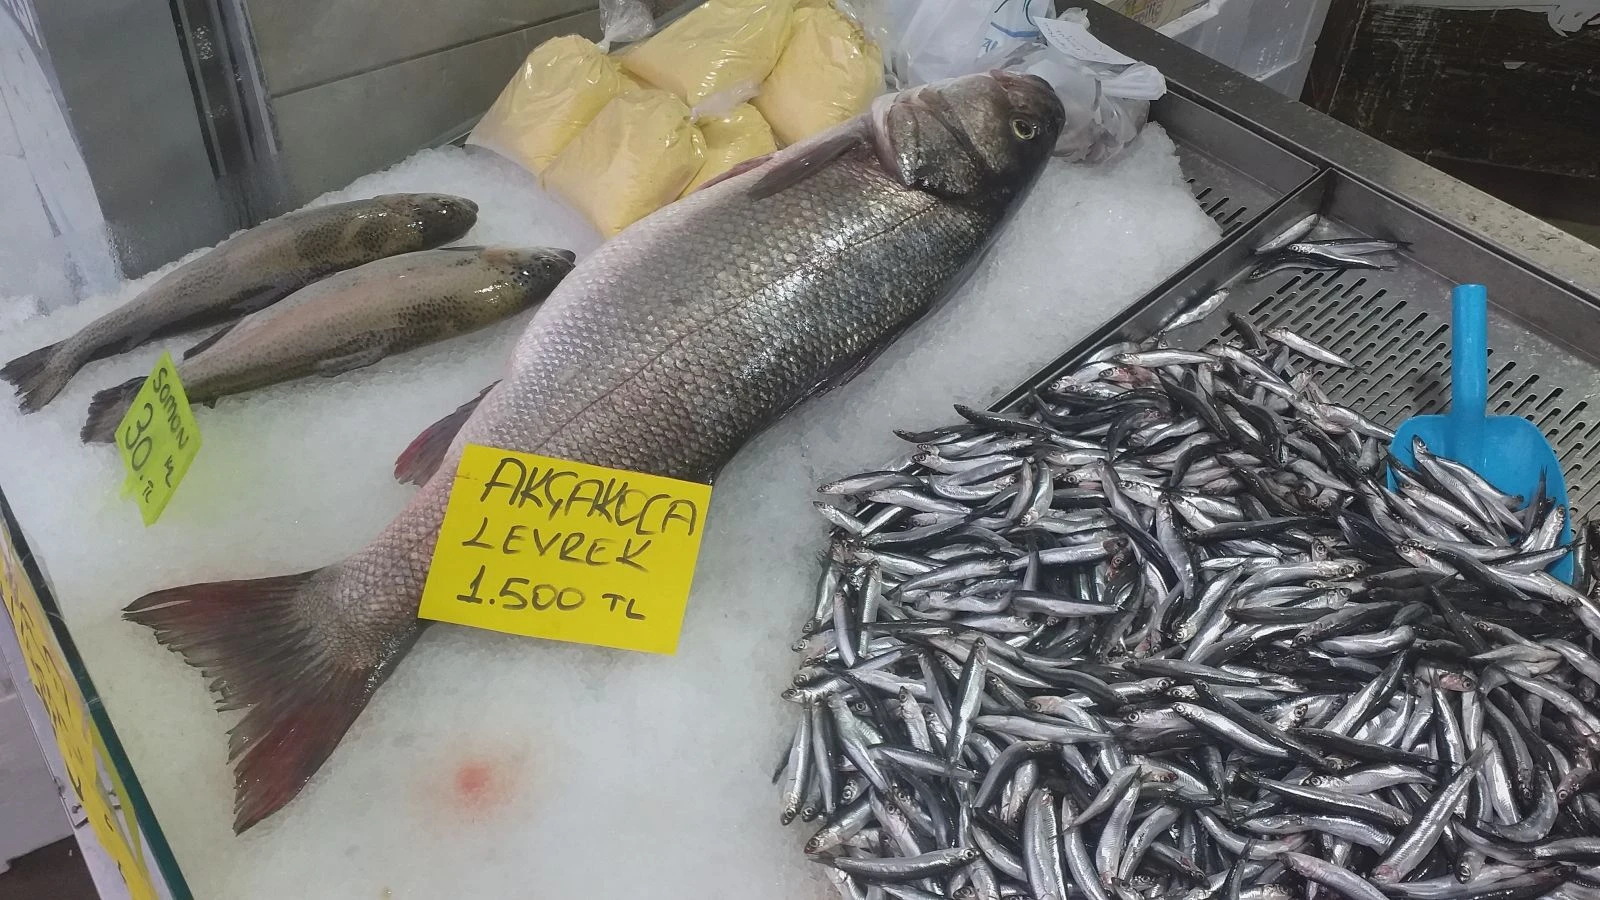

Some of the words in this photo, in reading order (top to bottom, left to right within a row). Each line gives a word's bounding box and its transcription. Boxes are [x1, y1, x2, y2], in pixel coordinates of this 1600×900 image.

[480, 457, 697, 535] AKÇAKOCA
[461, 517, 652, 573] LEVREK
[456, 565, 585, 611] 1.500
[601, 592, 646, 620] TL
